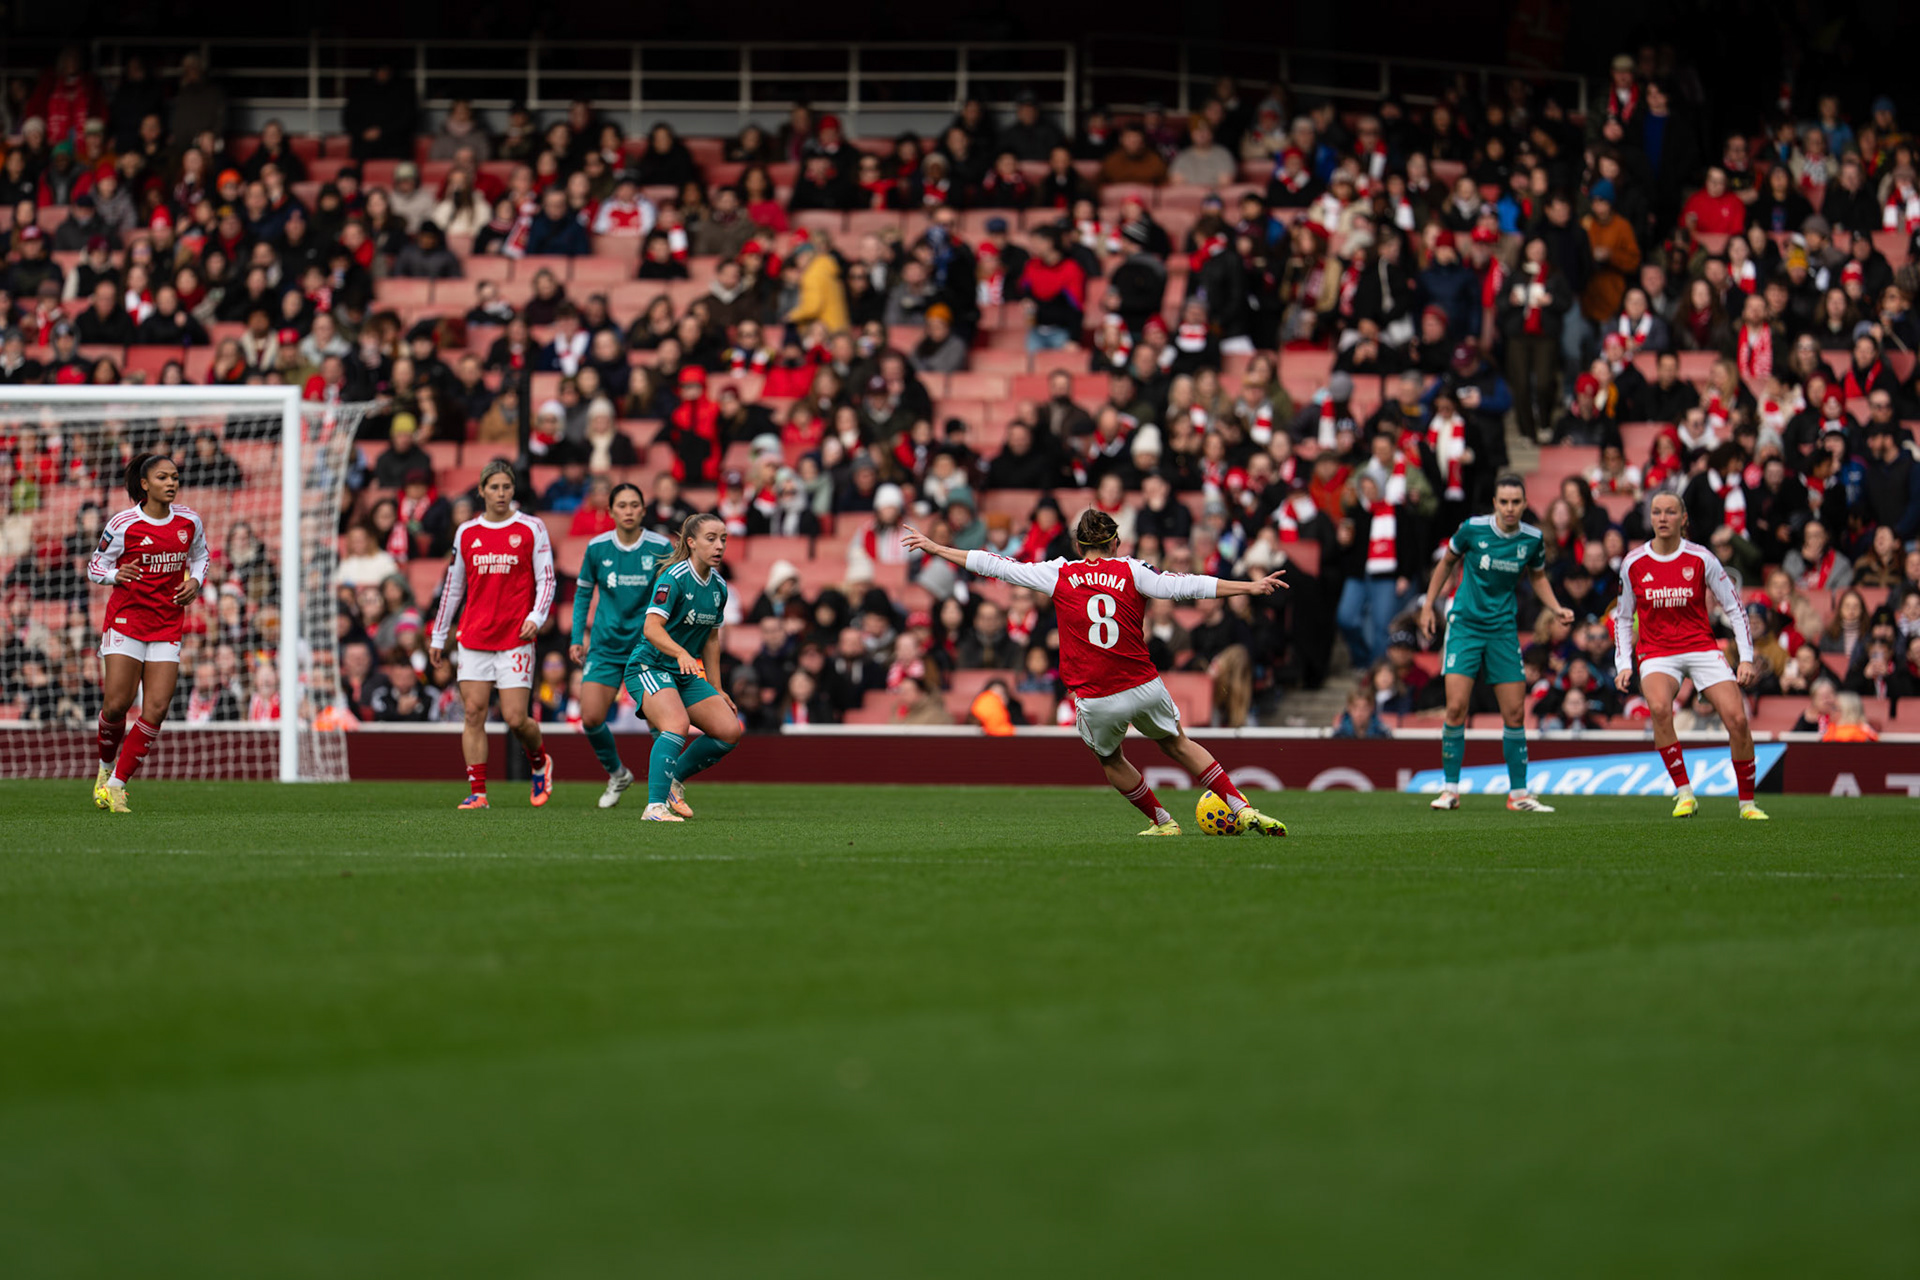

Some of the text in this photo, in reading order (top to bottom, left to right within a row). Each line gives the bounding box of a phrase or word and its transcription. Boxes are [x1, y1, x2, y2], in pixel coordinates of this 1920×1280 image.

[142, 551, 188, 564] Emirates
[473, 552, 519, 566] Emirates
[149, 563, 162, 573] FLY
[1645, 586, 1694, 600] Emirates
[1087, 594, 1119, 649] 8
[512, 652, 531, 674] 32
